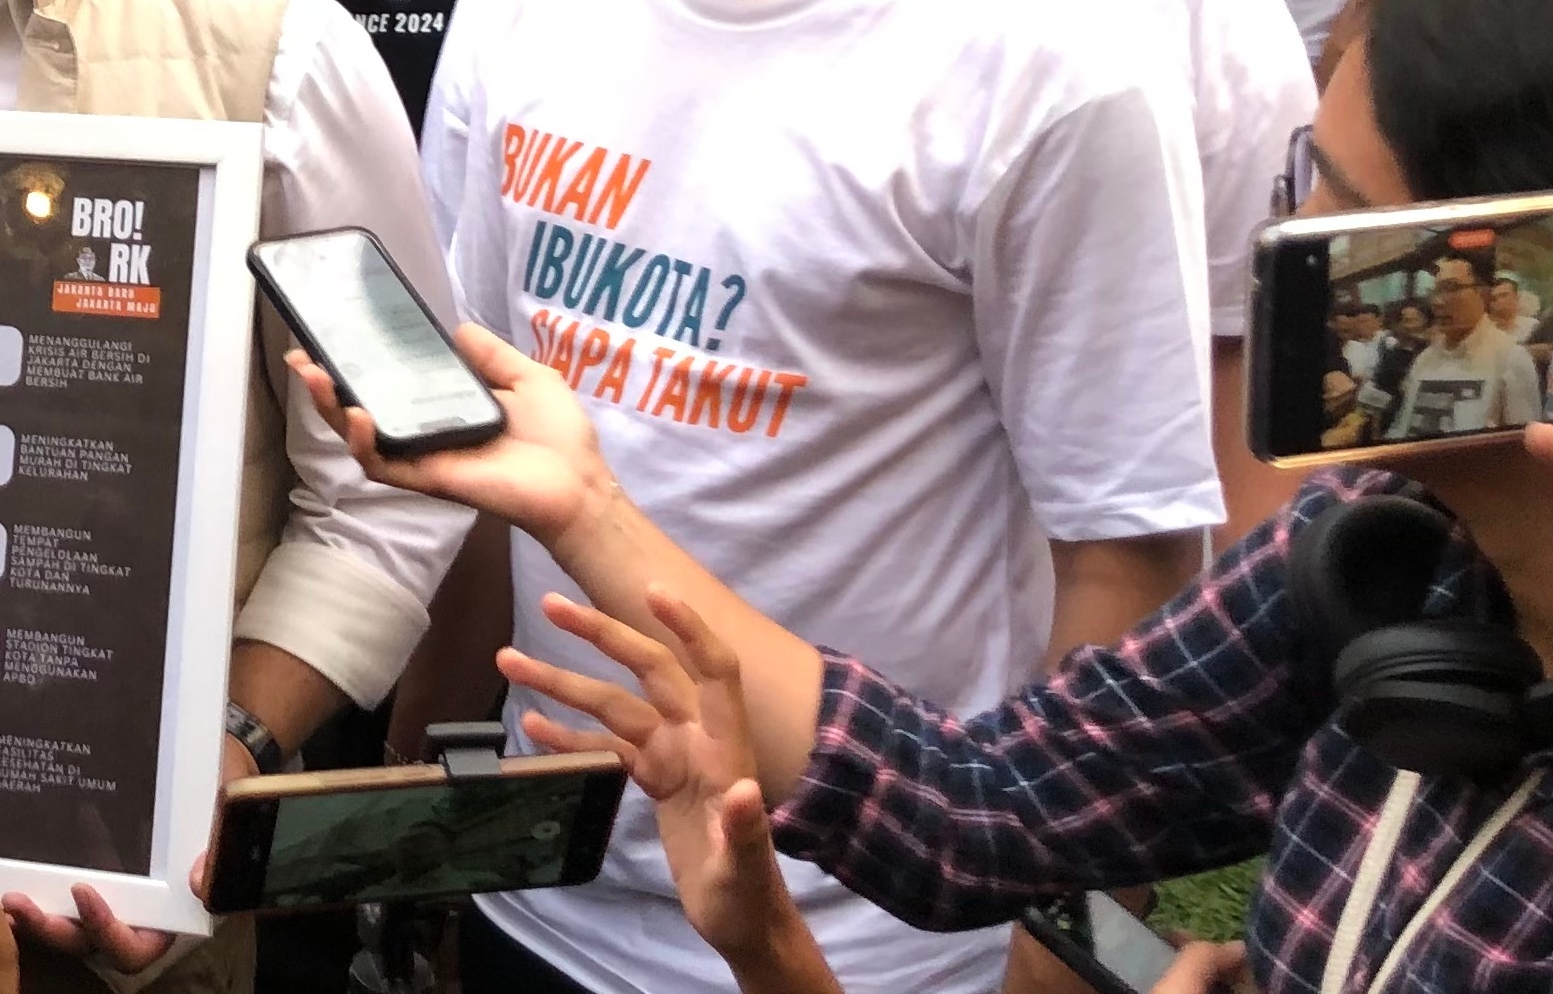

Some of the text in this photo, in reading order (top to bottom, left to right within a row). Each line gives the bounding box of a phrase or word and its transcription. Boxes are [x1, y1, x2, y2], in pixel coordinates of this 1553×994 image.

[353, 12, 445, 32] NCE 2024
[500, 122, 652, 230] BUKAN
[71, 197, 144, 240] BRO!
[108, 242, 152, 285] RK
[57, 283, 135, 299] JAKARTA BARU
[522, 219, 747, 351] IBUKOTA?
[76, 299, 122, 311] JAKARTA
[28, 334, 132, 351] MENANGGULANGI
[28, 346, 150, 363] KRISIS AIR BERSIH DI
[27, 356, 132, 372] JAKARTA DENGAN
[25, 376, 68, 389] BERSIH
[26, 366, 144, 384] MEMBUAT BANK AIR
[529, 309, 808, 439] SIAPA TAKUT
[21, 433, 114, 451] MENINGKATKAN
[20, 445, 129, 463] BANTUAN PANGAN
[18, 465, 88, 481] KELURAHAN
[19, 455, 133, 474] MURAH DI TINGKAT
[13, 524, 92, 540] MEMBANGUN
[13, 535, 59, 547] TEMPAT
[11, 545, 98, 562] PENGELOLAAN
[10, 567, 70, 582] KOTA DAN
[11, 557, 131, 577] SAMPAH DI TINGKAT
[9, 576, 90, 595] TURUNANNYA
[6, 628, 85, 646] MEMBANGUN
[5, 639, 114, 660] STADION TINGKAT
[5, 650, 79, 667] KOTA TANPA
[4, 662, 97, 680] MENGGUNAKAN
[67, 764, 81, 775] DI
[78, 777, 117, 791] UMUM
